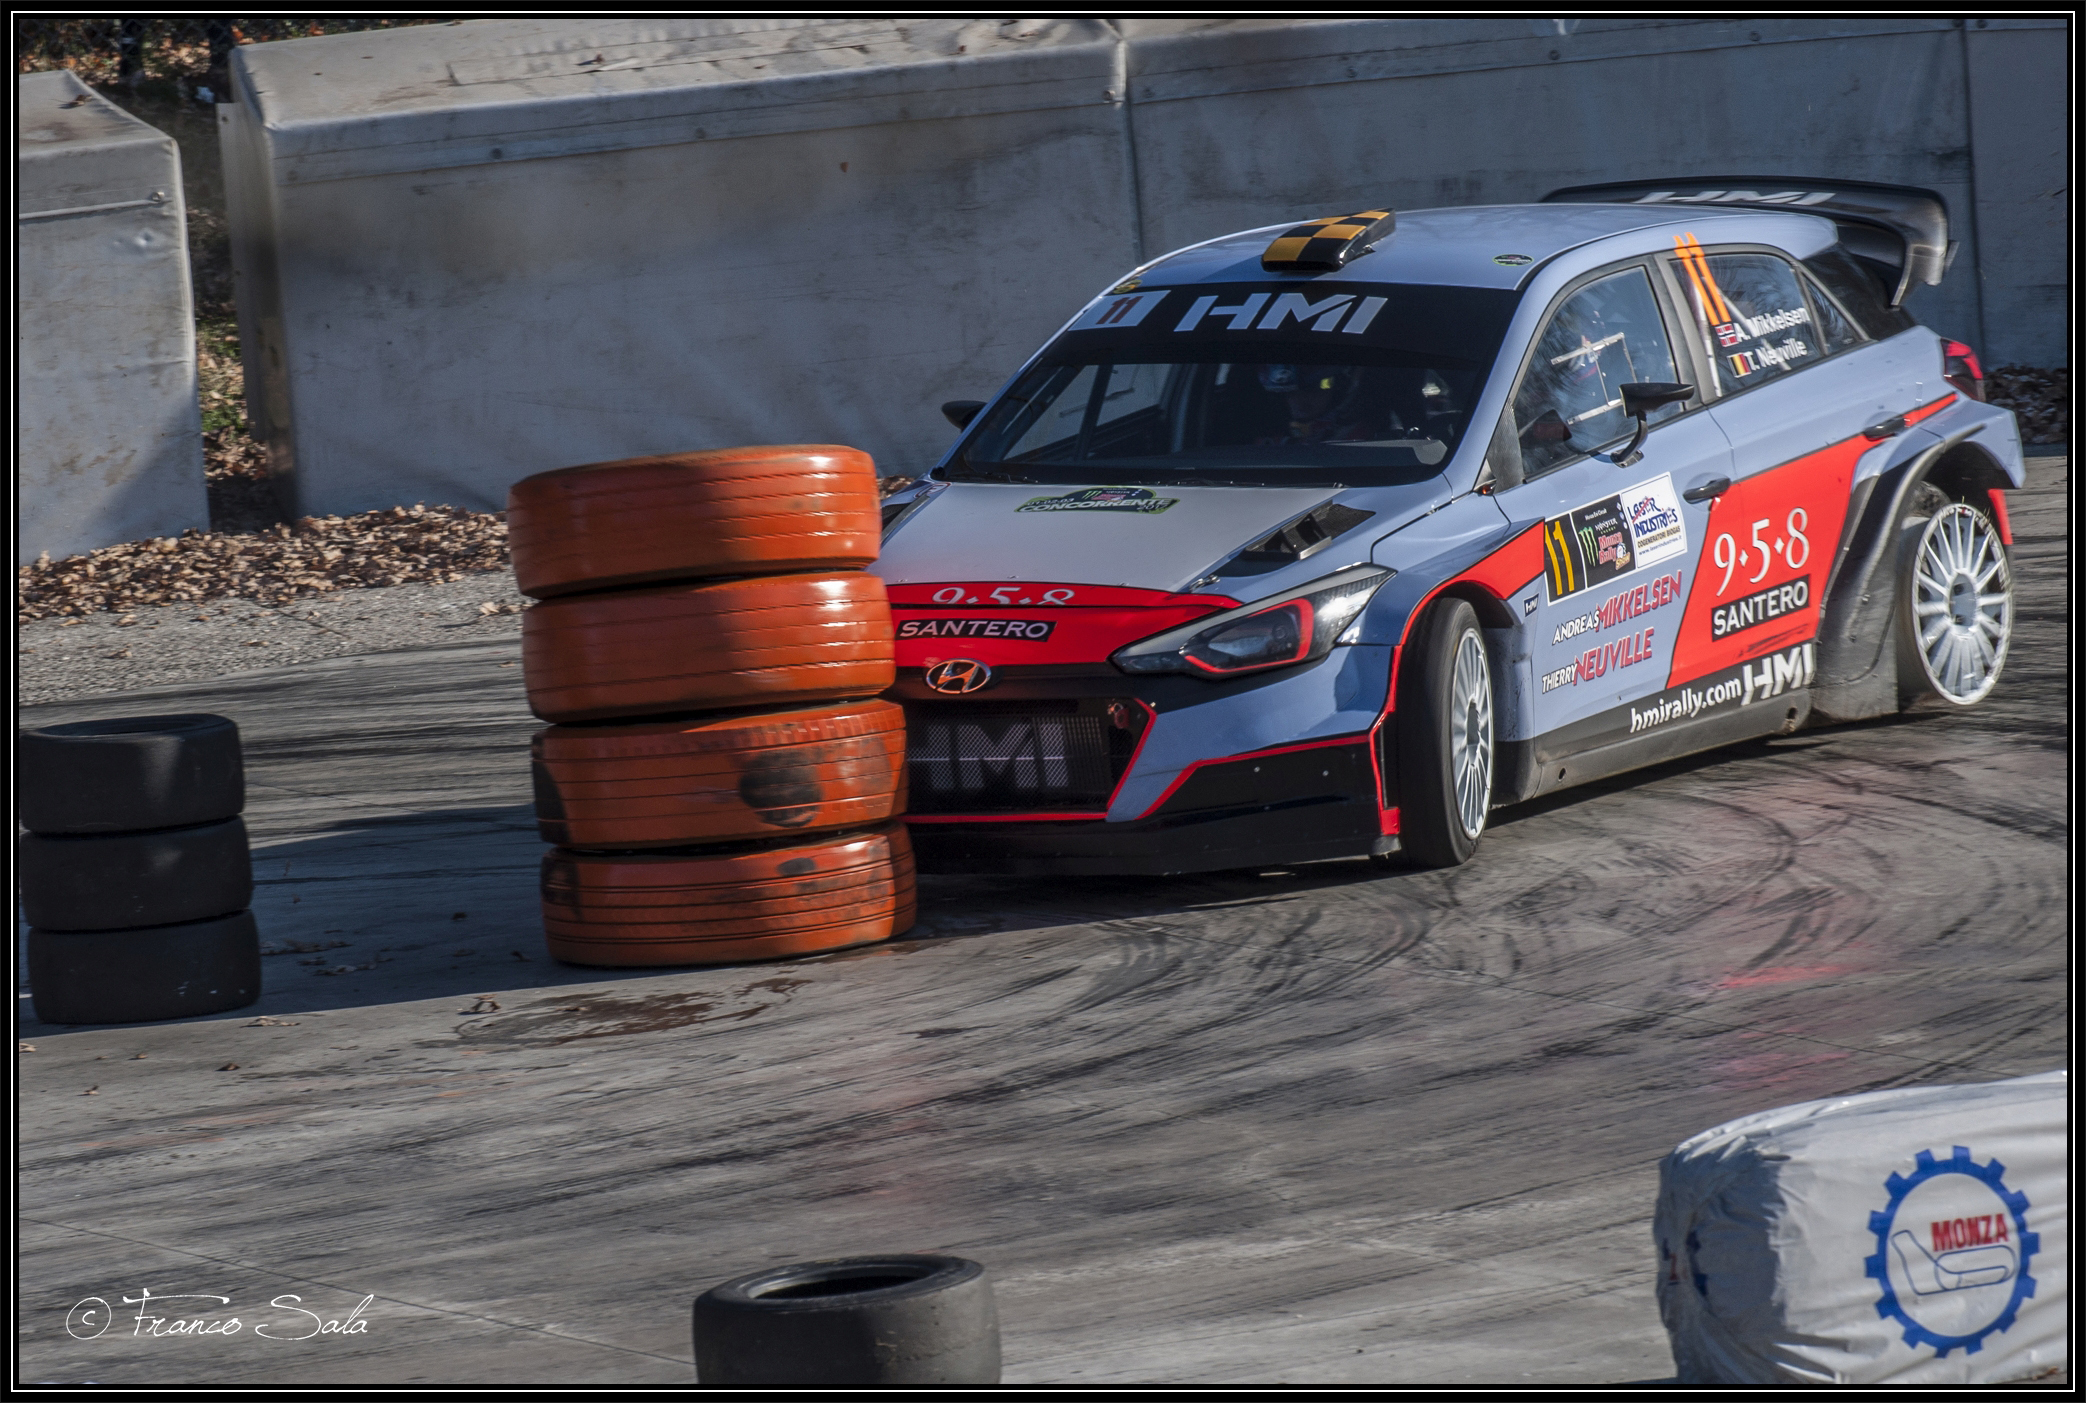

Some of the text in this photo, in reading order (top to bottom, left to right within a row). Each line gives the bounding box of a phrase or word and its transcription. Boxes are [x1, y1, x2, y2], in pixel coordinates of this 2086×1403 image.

[1633, 190, 1836, 206] HMI
[1673, 231, 1731, 326] 11
[1095, 295, 1144, 325] 11
[1173, 292, 1388, 334] HMI
[1733, 307, 1811, 343] A. Mikkelsen
[1744, 350, 1760, 371] T.
[1019, 499, 1172, 512] CONCORRENTE
[1633, 507, 1679, 538] INDUSTRIES
[1545, 520, 1575, 596] 11
[1552, 569, 1683, 646] ANDREAS MIKKELSEN
[1713, 581, 1809, 636] SANTERO
[900, 620, 1049, 639] SANTERO
[1542, 626, 1655, 695] THIERRY NEUVILLE
[1630, 643, 1816, 734] hmirally.com HMI
[1930, 1213, 2010, 1253] MONZA
